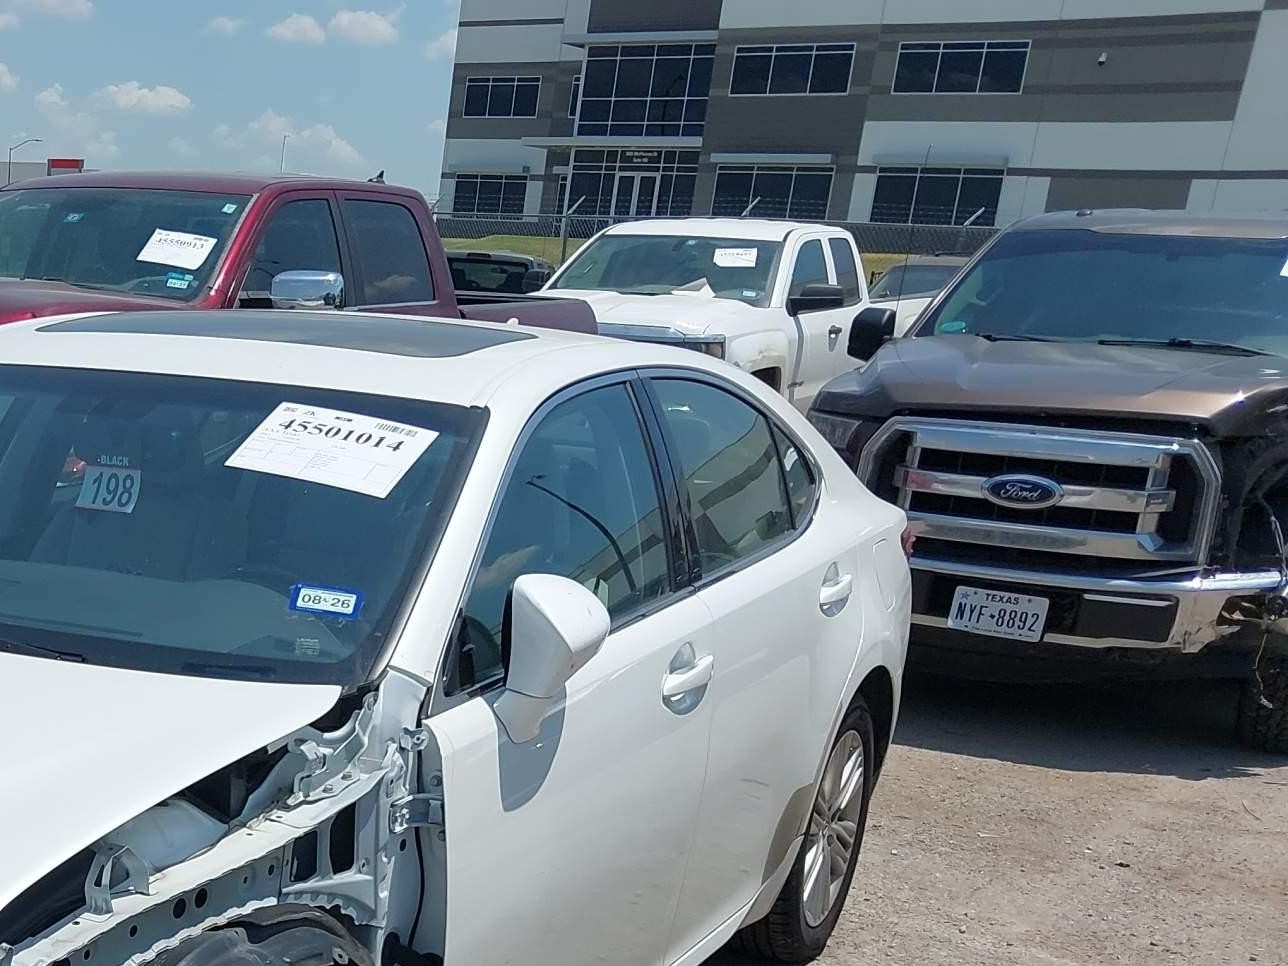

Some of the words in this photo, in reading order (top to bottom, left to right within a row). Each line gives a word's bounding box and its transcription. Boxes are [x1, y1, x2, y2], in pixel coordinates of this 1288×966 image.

[279, 418, 405, 452] 45501014
[91, 471, 135, 508] 198
[1000, 482, 1042, 501] Ford
[984, 592, 1020, 605] TEXAS
